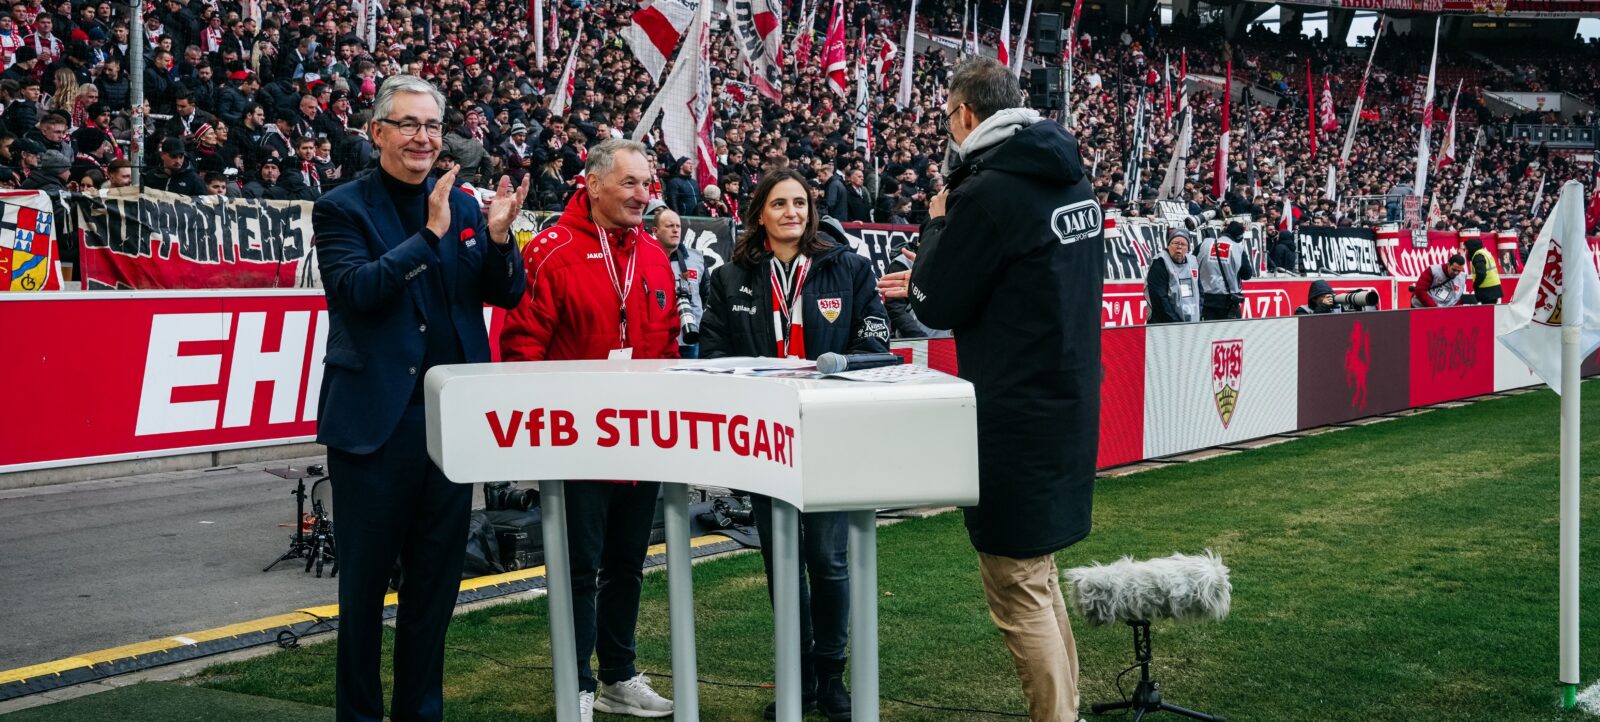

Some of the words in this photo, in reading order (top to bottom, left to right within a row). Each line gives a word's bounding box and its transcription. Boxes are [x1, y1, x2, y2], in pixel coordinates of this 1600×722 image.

[1062, 207, 1100, 236] JAKO
[739, 285, 753, 296] JAK
[134, 310, 328, 437] EH
[485, 407, 579, 447] VfB
[595, 408, 794, 467] STUTTGART
